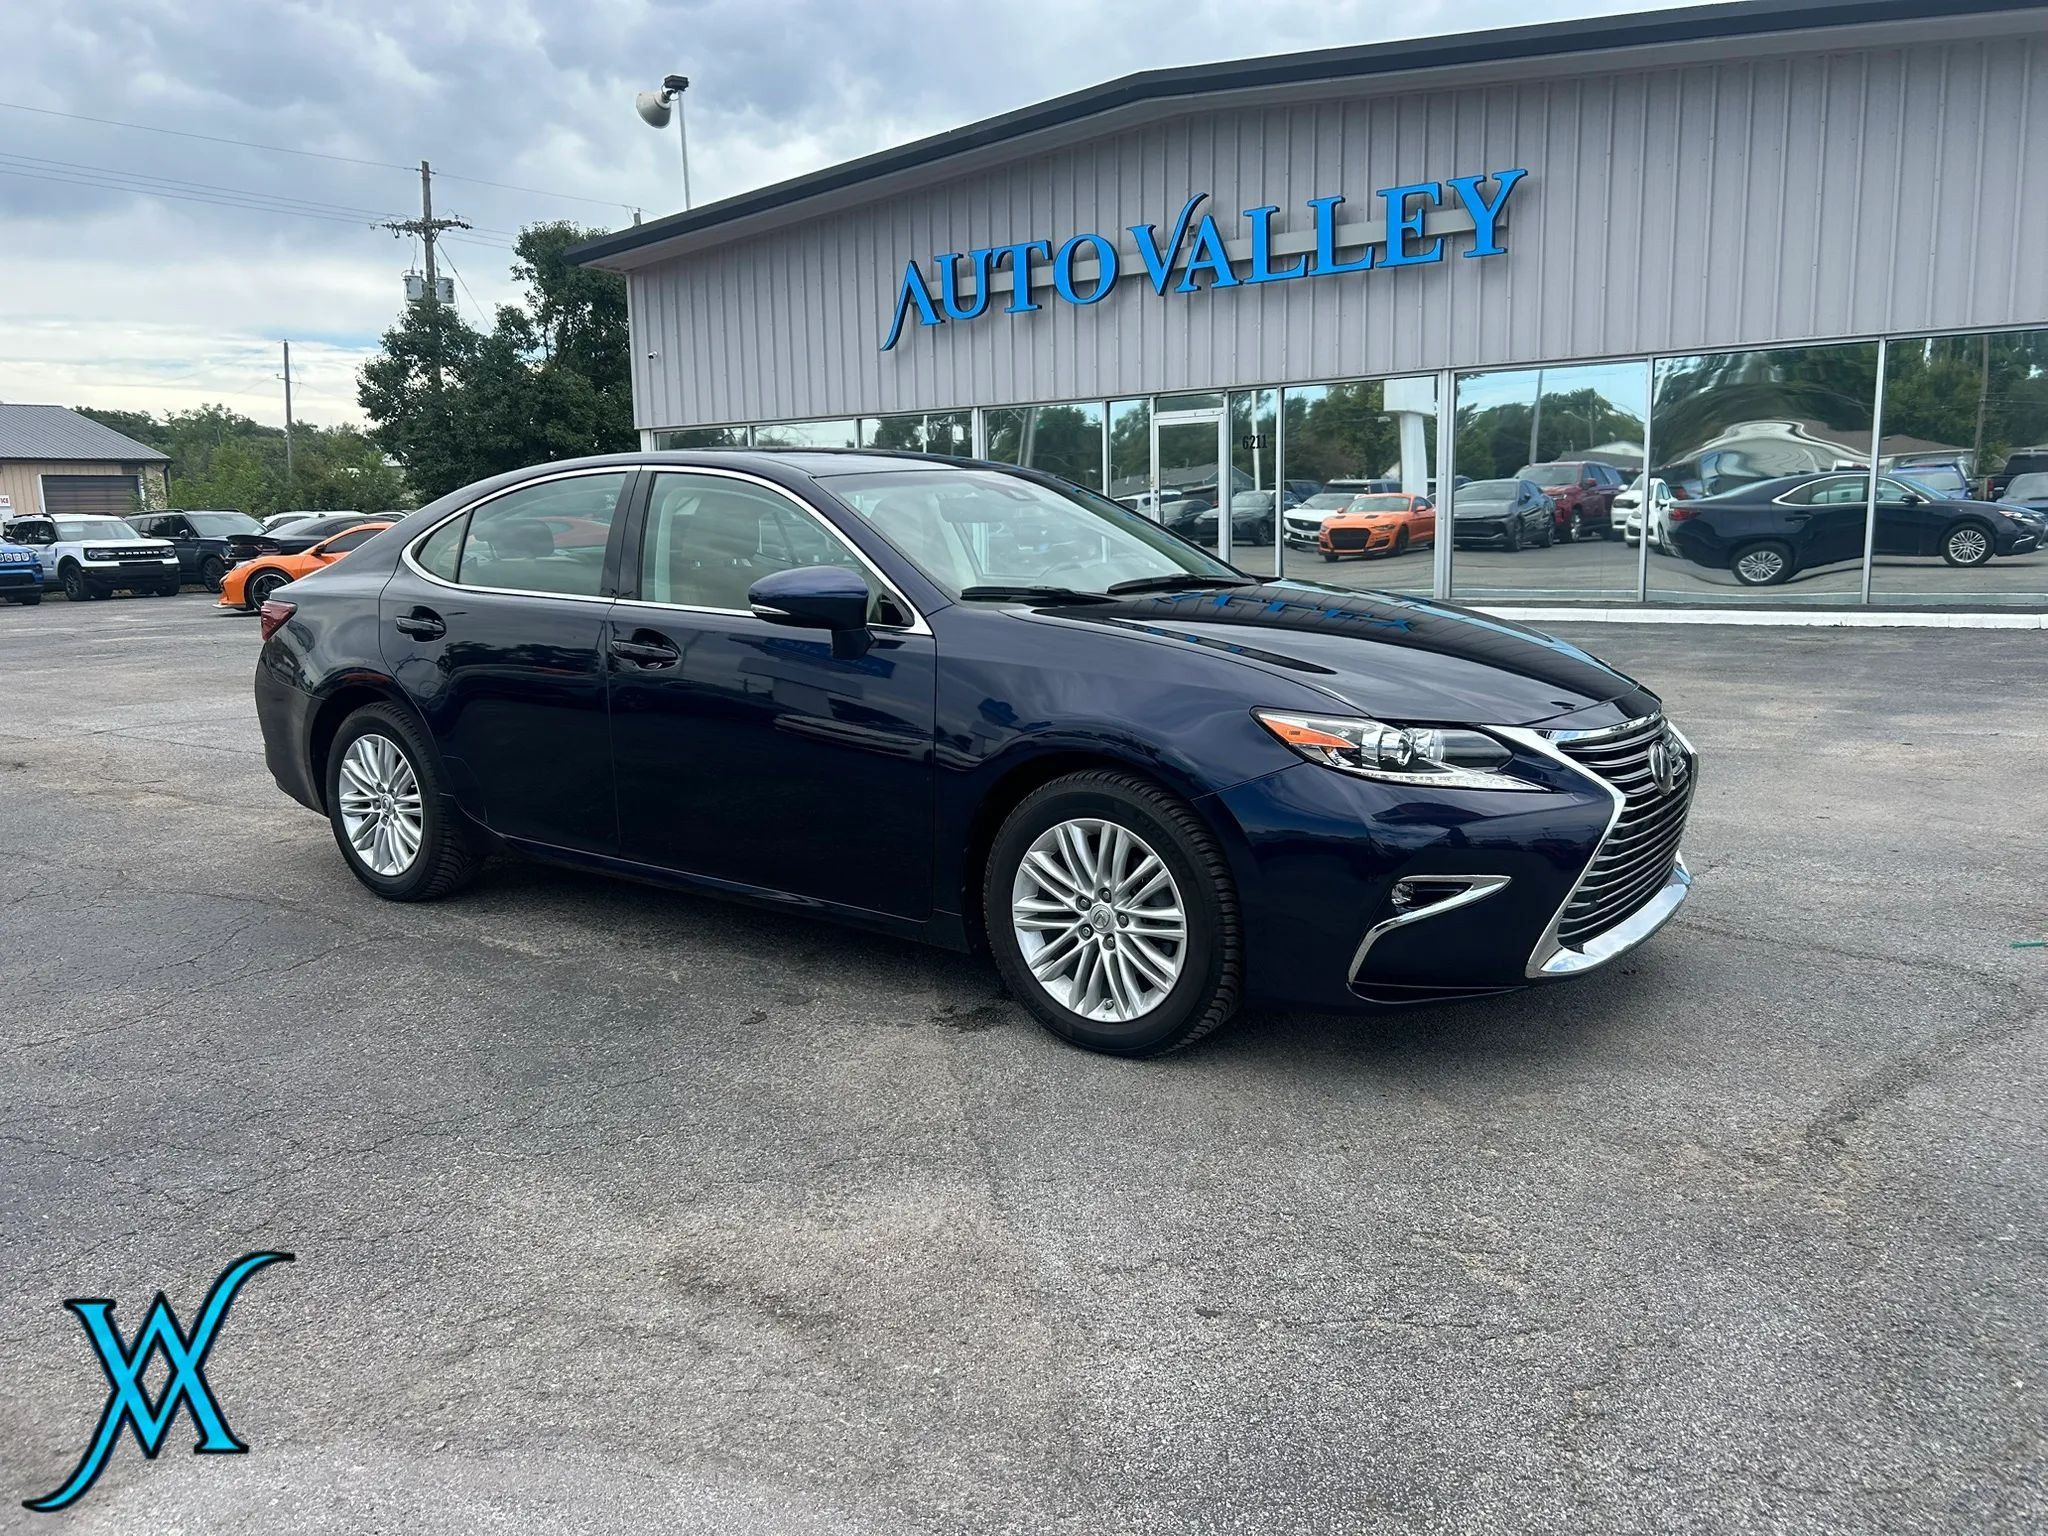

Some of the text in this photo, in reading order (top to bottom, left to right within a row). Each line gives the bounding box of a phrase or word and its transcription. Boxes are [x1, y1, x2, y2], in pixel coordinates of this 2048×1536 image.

[880, 168, 1528, 351] AUTO VALLEY
[1242, 434, 1267, 449] 6211
